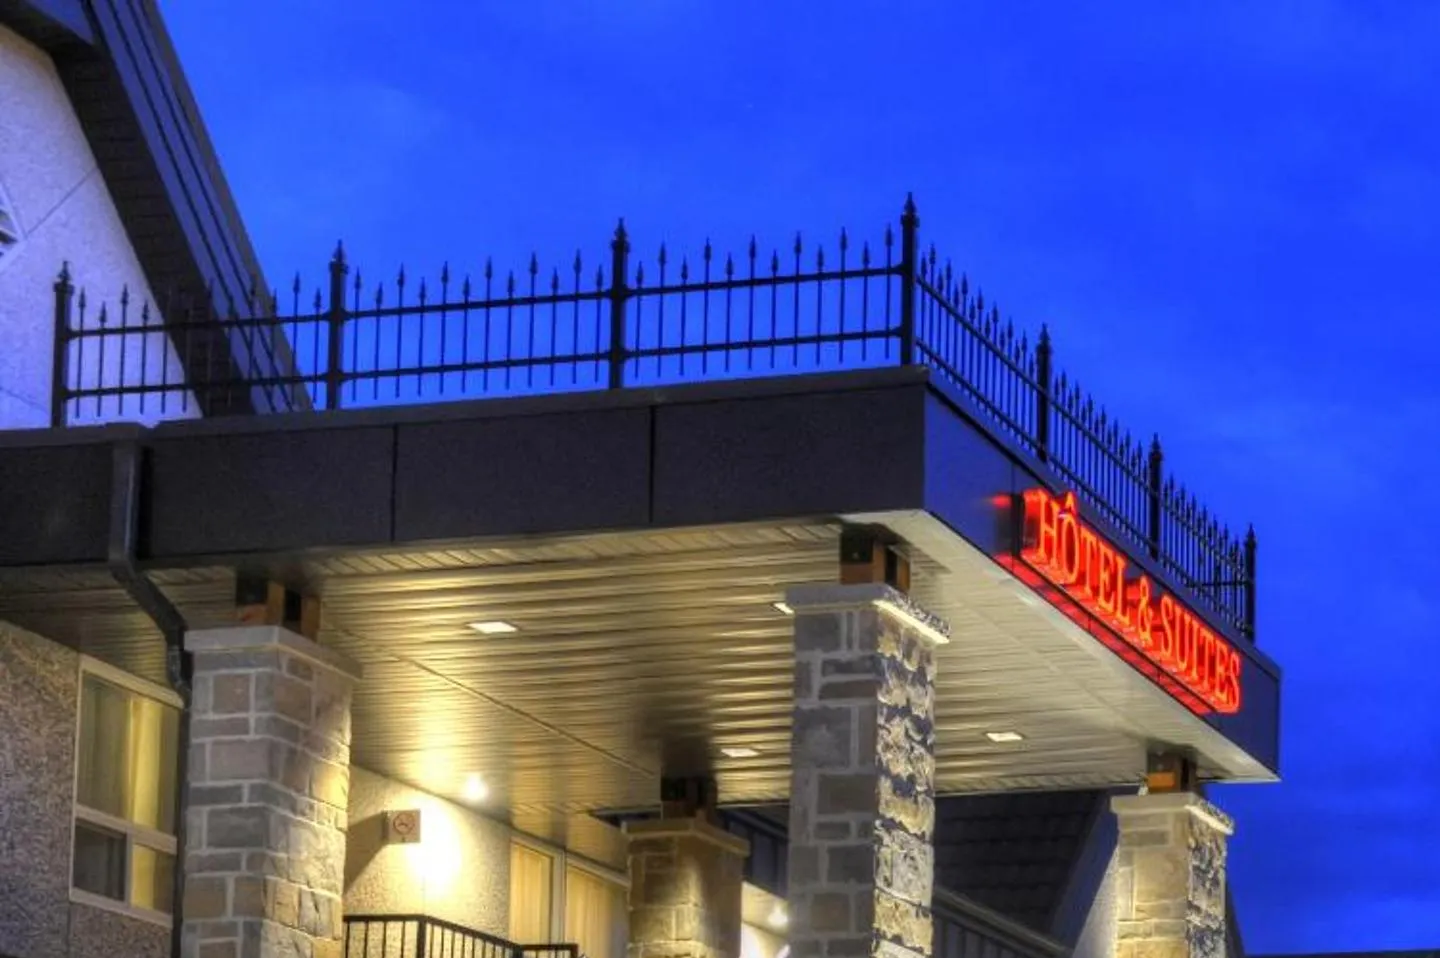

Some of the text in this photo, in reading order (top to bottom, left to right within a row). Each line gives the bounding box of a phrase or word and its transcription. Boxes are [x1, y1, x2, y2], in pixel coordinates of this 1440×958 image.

[1035, 488, 1242, 712] HÔTEL & SUITES
